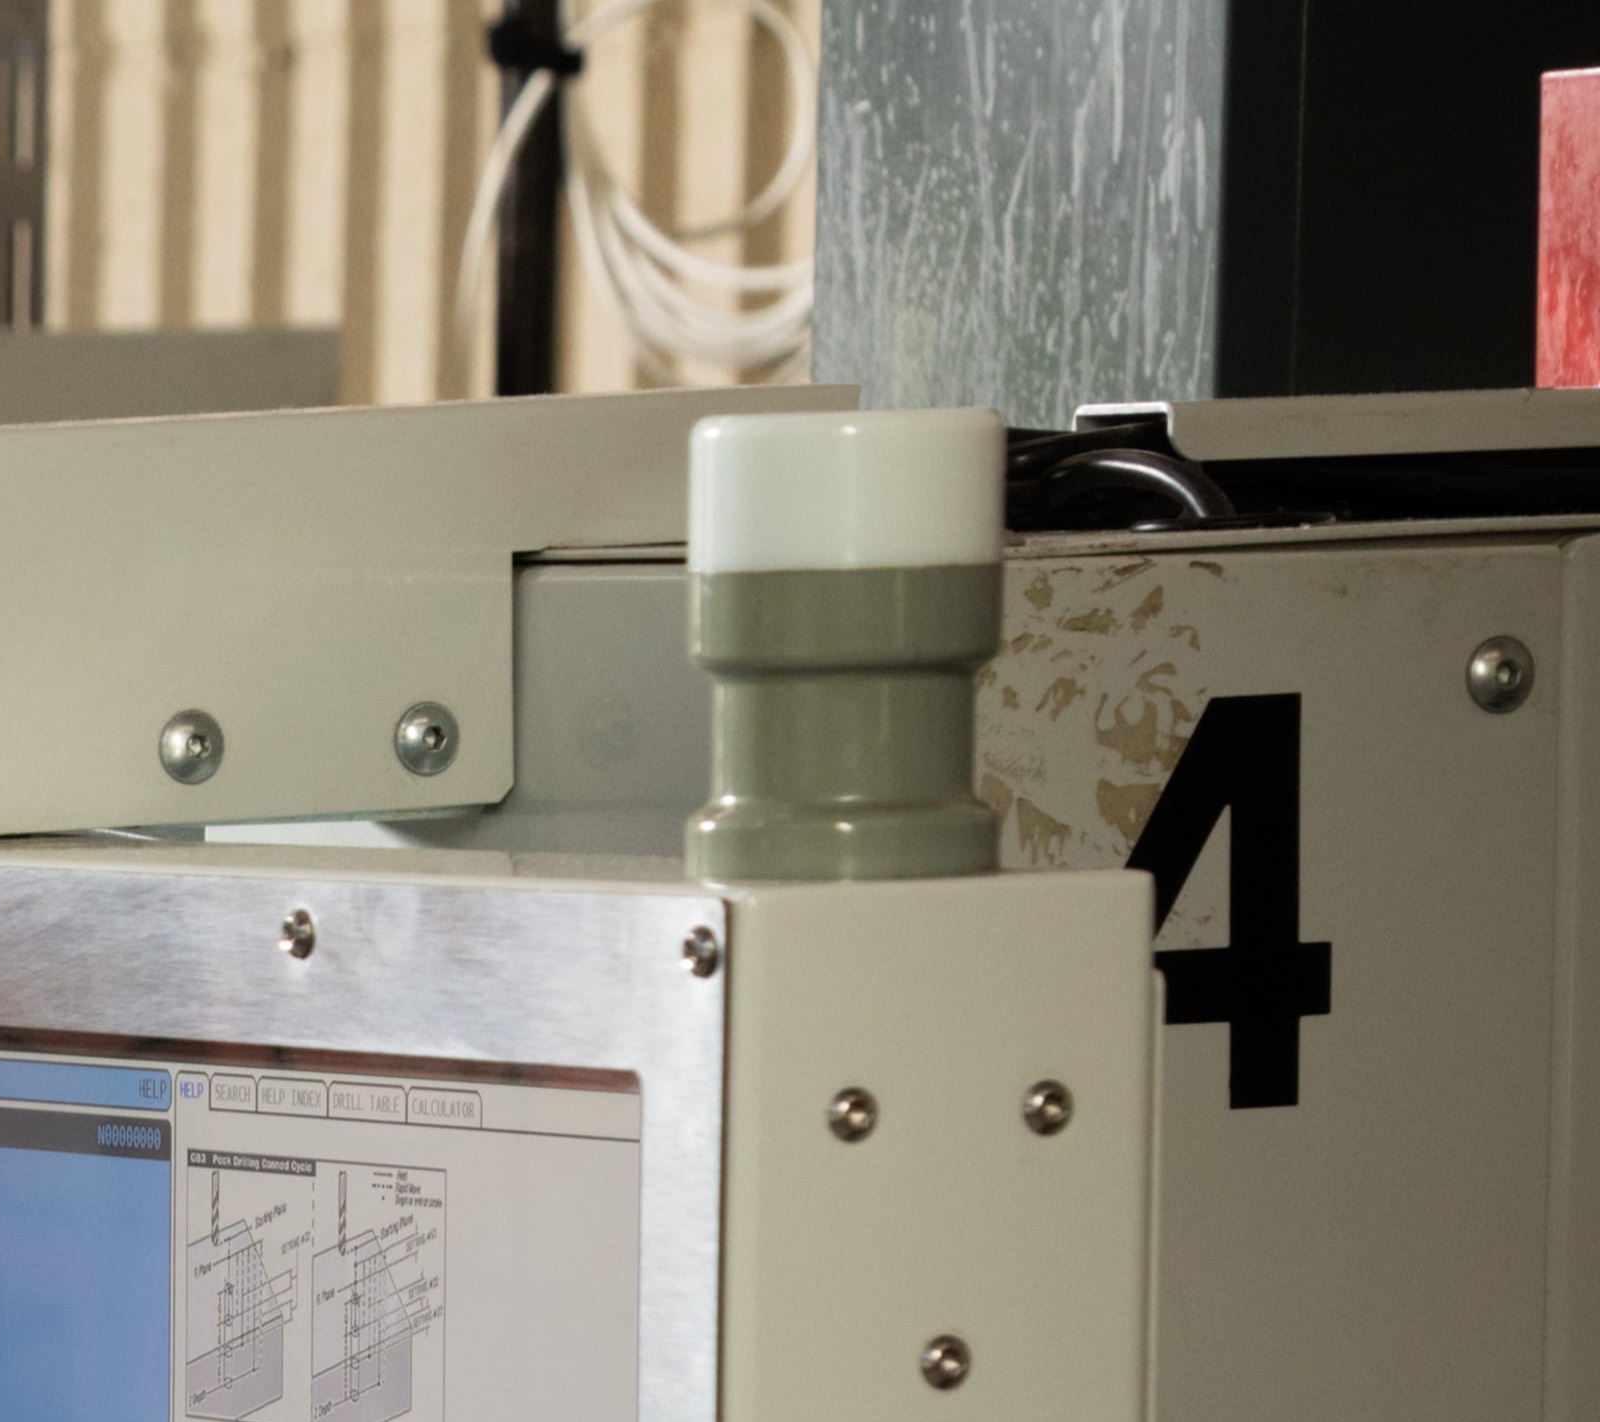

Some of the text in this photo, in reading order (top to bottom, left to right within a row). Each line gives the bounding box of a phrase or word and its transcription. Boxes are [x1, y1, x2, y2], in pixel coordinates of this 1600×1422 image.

[1124, 692, 1331, 1109] 4
[139, 1079, 167, 1099] HELP
[180, 1081, 204, 1099] HELP
[215, 1084, 250, 1103] SEARCH
[261, 1087, 321, 1108] HELP INDEX
[333, 1092, 400, 1114] DRILL TABLE
[412, 1098, 475, 1119] CALCULATOR
